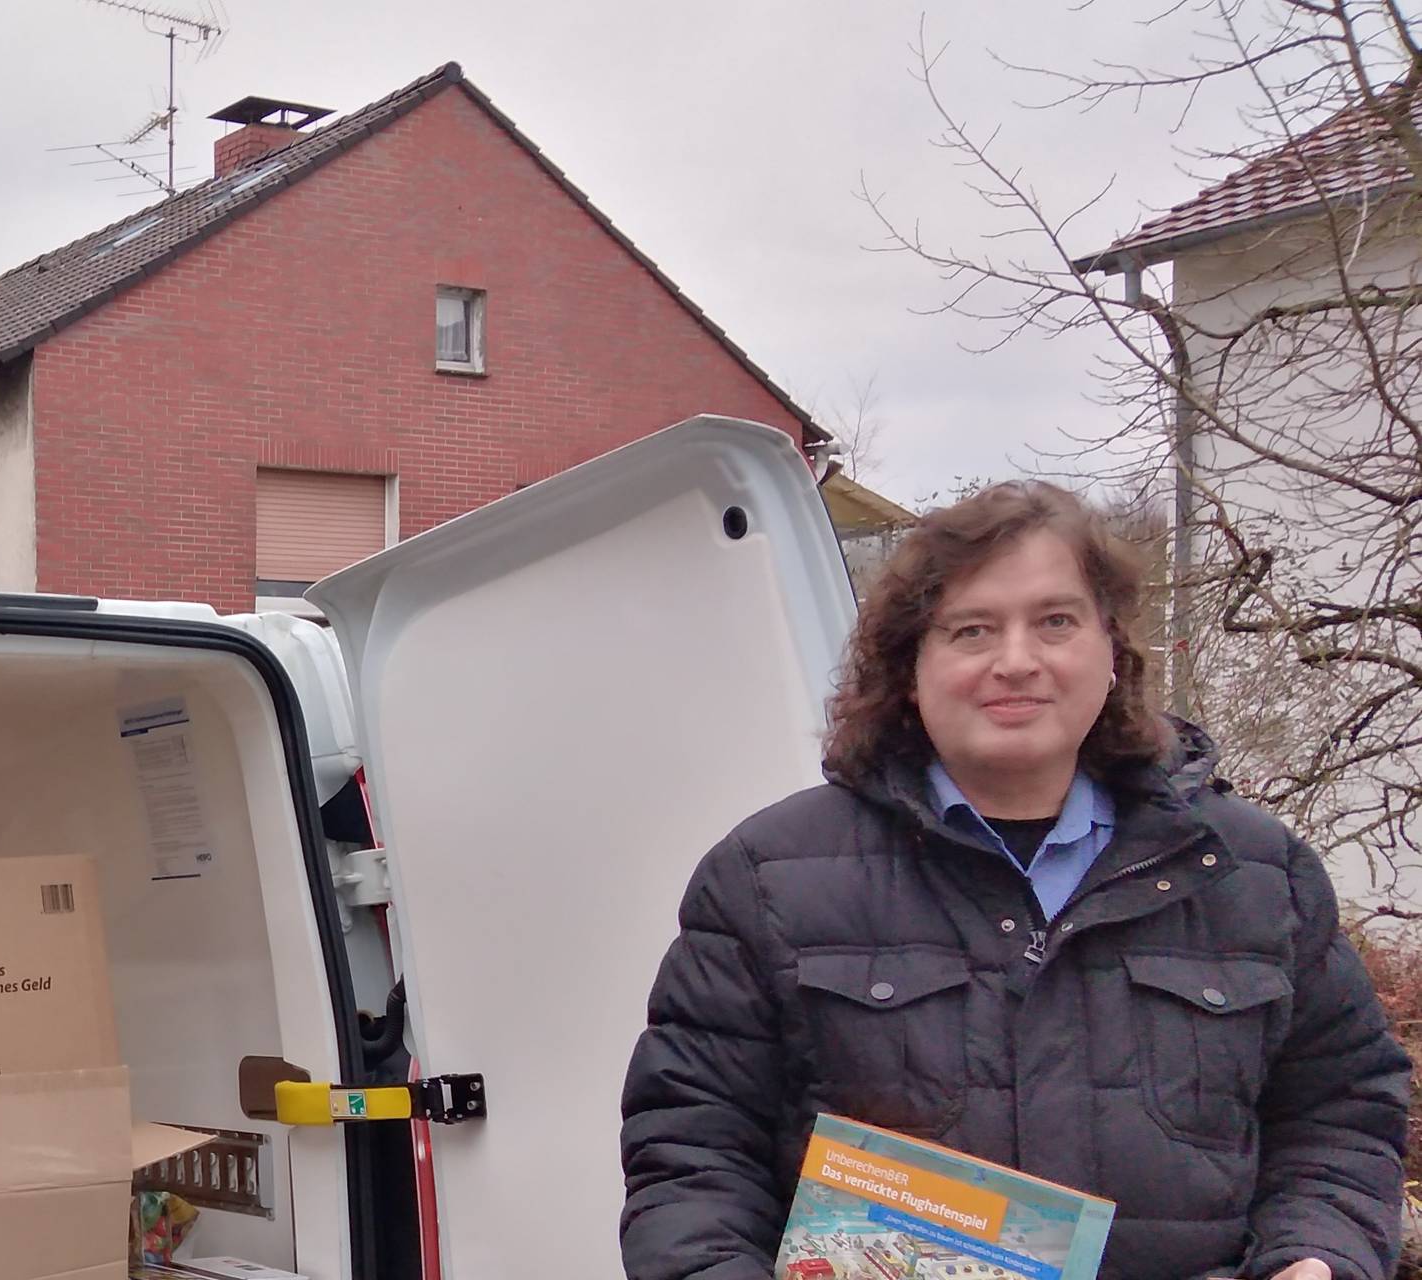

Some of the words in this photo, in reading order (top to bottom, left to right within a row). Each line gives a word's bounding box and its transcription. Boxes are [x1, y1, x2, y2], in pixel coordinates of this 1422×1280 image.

[21, 976, 51, 992] Geld
[821, 1164, 843, 1182] Das
[844, 1173, 899, 1201] verrückte
[900, 1191, 989, 1231] Flughafenspiel
